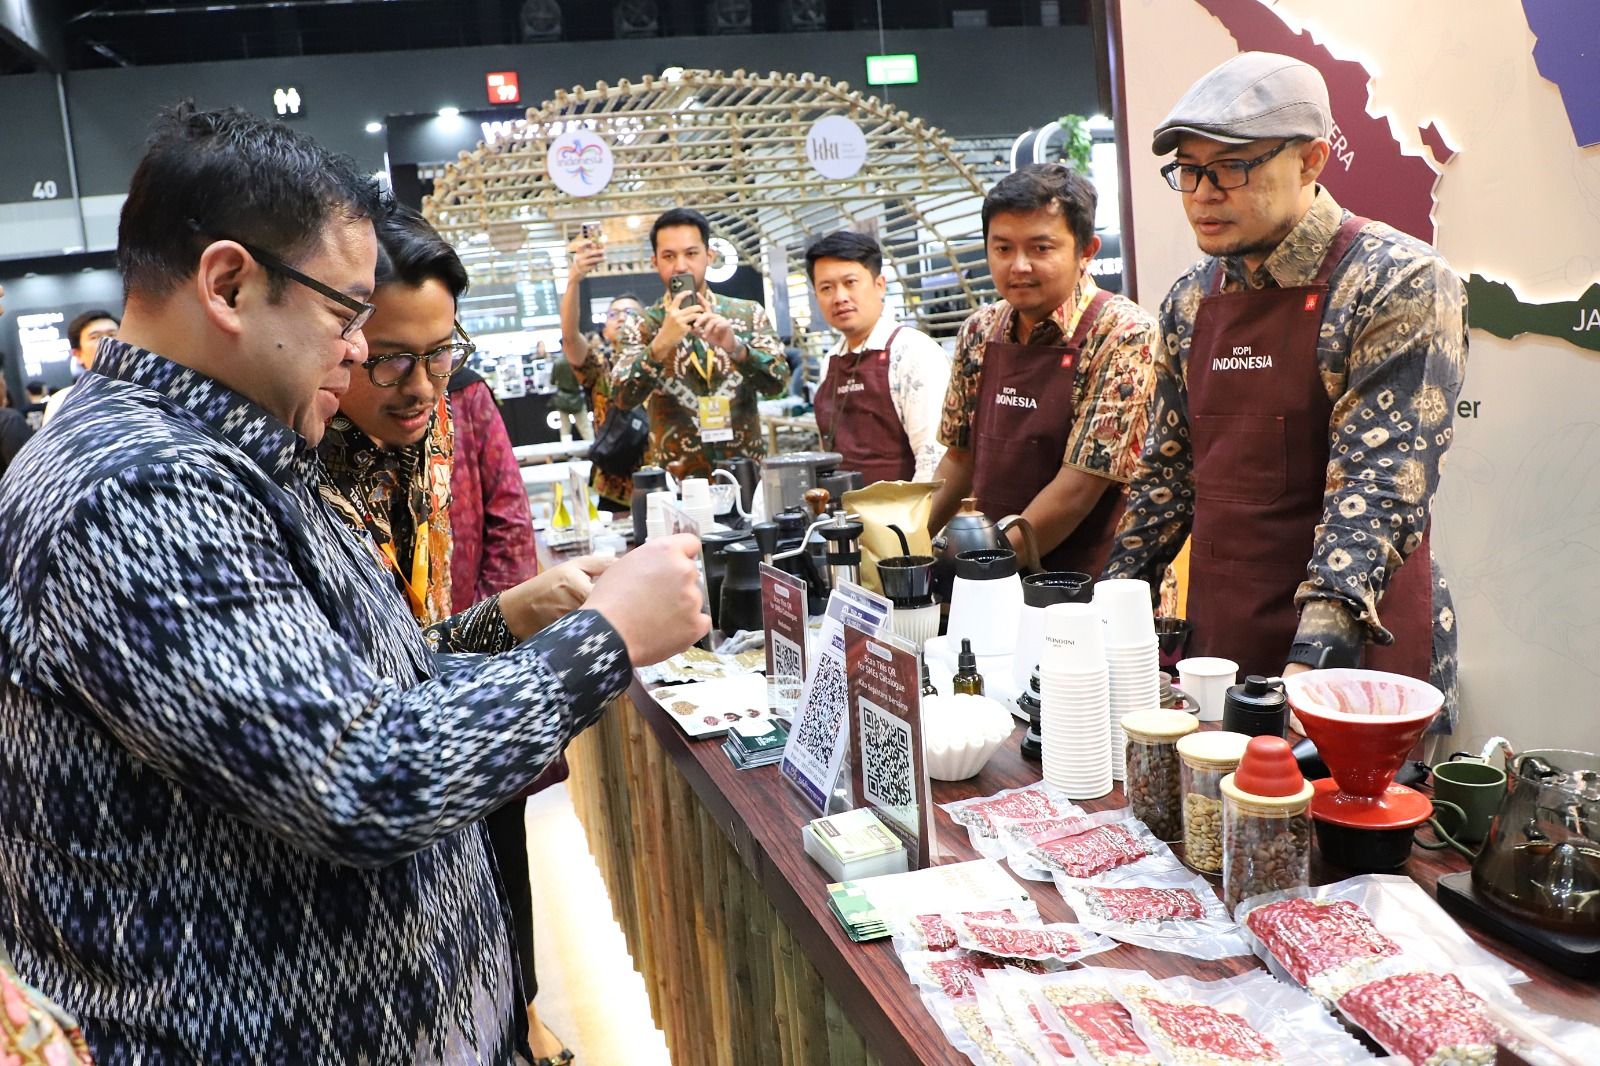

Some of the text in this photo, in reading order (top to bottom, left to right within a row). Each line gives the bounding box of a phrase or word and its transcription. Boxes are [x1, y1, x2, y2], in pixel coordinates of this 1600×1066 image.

[1328, 119, 1355, 171] ERA
[32, 180, 58, 199] 40
[1572, 308, 1600, 331] JA
[1232, 346, 1251, 356] KOPI
[1212, 355, 1273, 371] INDONESIA
[1457, 400, 1481, 419] er
[864, 654, 896, 678] Scan This QR
[865, 665, 879, 679] SMEs
[879, 673, 905, 693] Catalogue
